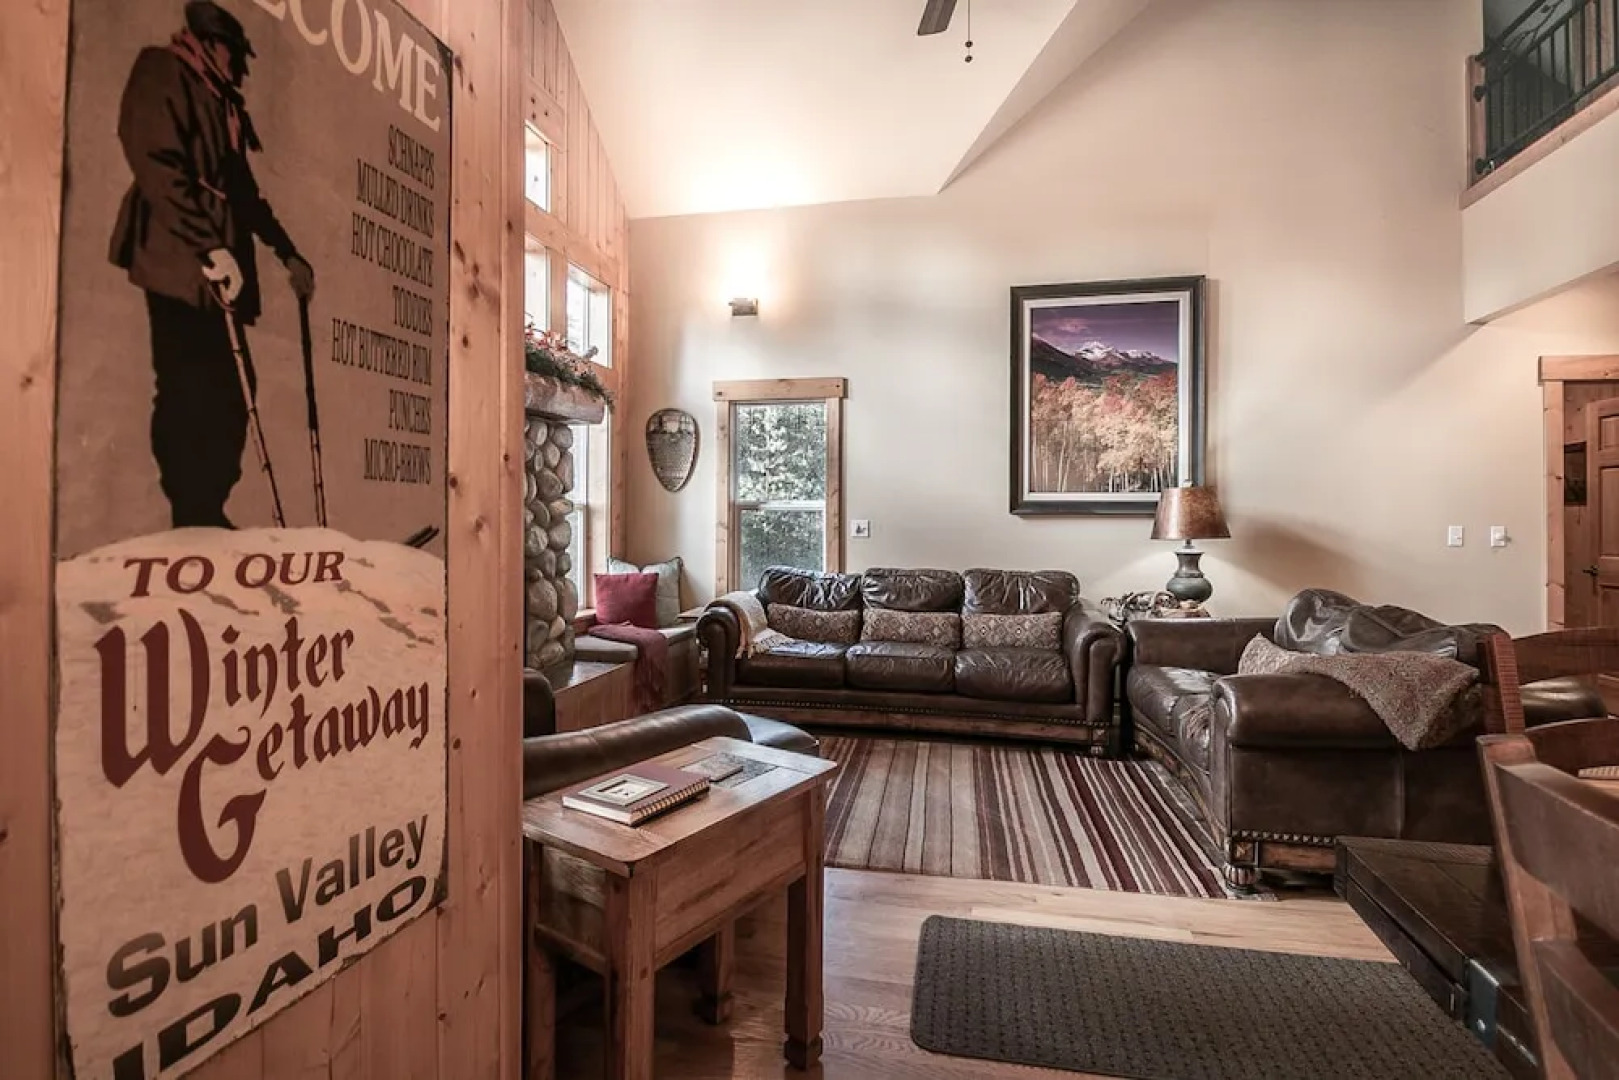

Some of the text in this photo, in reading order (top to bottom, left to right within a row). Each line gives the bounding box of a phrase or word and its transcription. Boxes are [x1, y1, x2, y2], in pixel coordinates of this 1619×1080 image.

[250, 0, 440, 132] COME
[388, 124, 435, 190] SCHNAPPS
[351, 212, 433, 288] HOT CHOCOLATE
[332, 318, 357, 366] HOT
[358, 326, 410, 380] BUTTERED
[393, 285, 432, 337] TODDIES
[389, 389, 431, 435] PUNCHES
[123, 550, 346, 598] TO OUR
[94, 608, 354, 788] Winter
[177, 682, 430, 884] Getaway
[106, 814, 429, 1018] Sun Valley
[112, 875, 427, 1080] IDAHO
